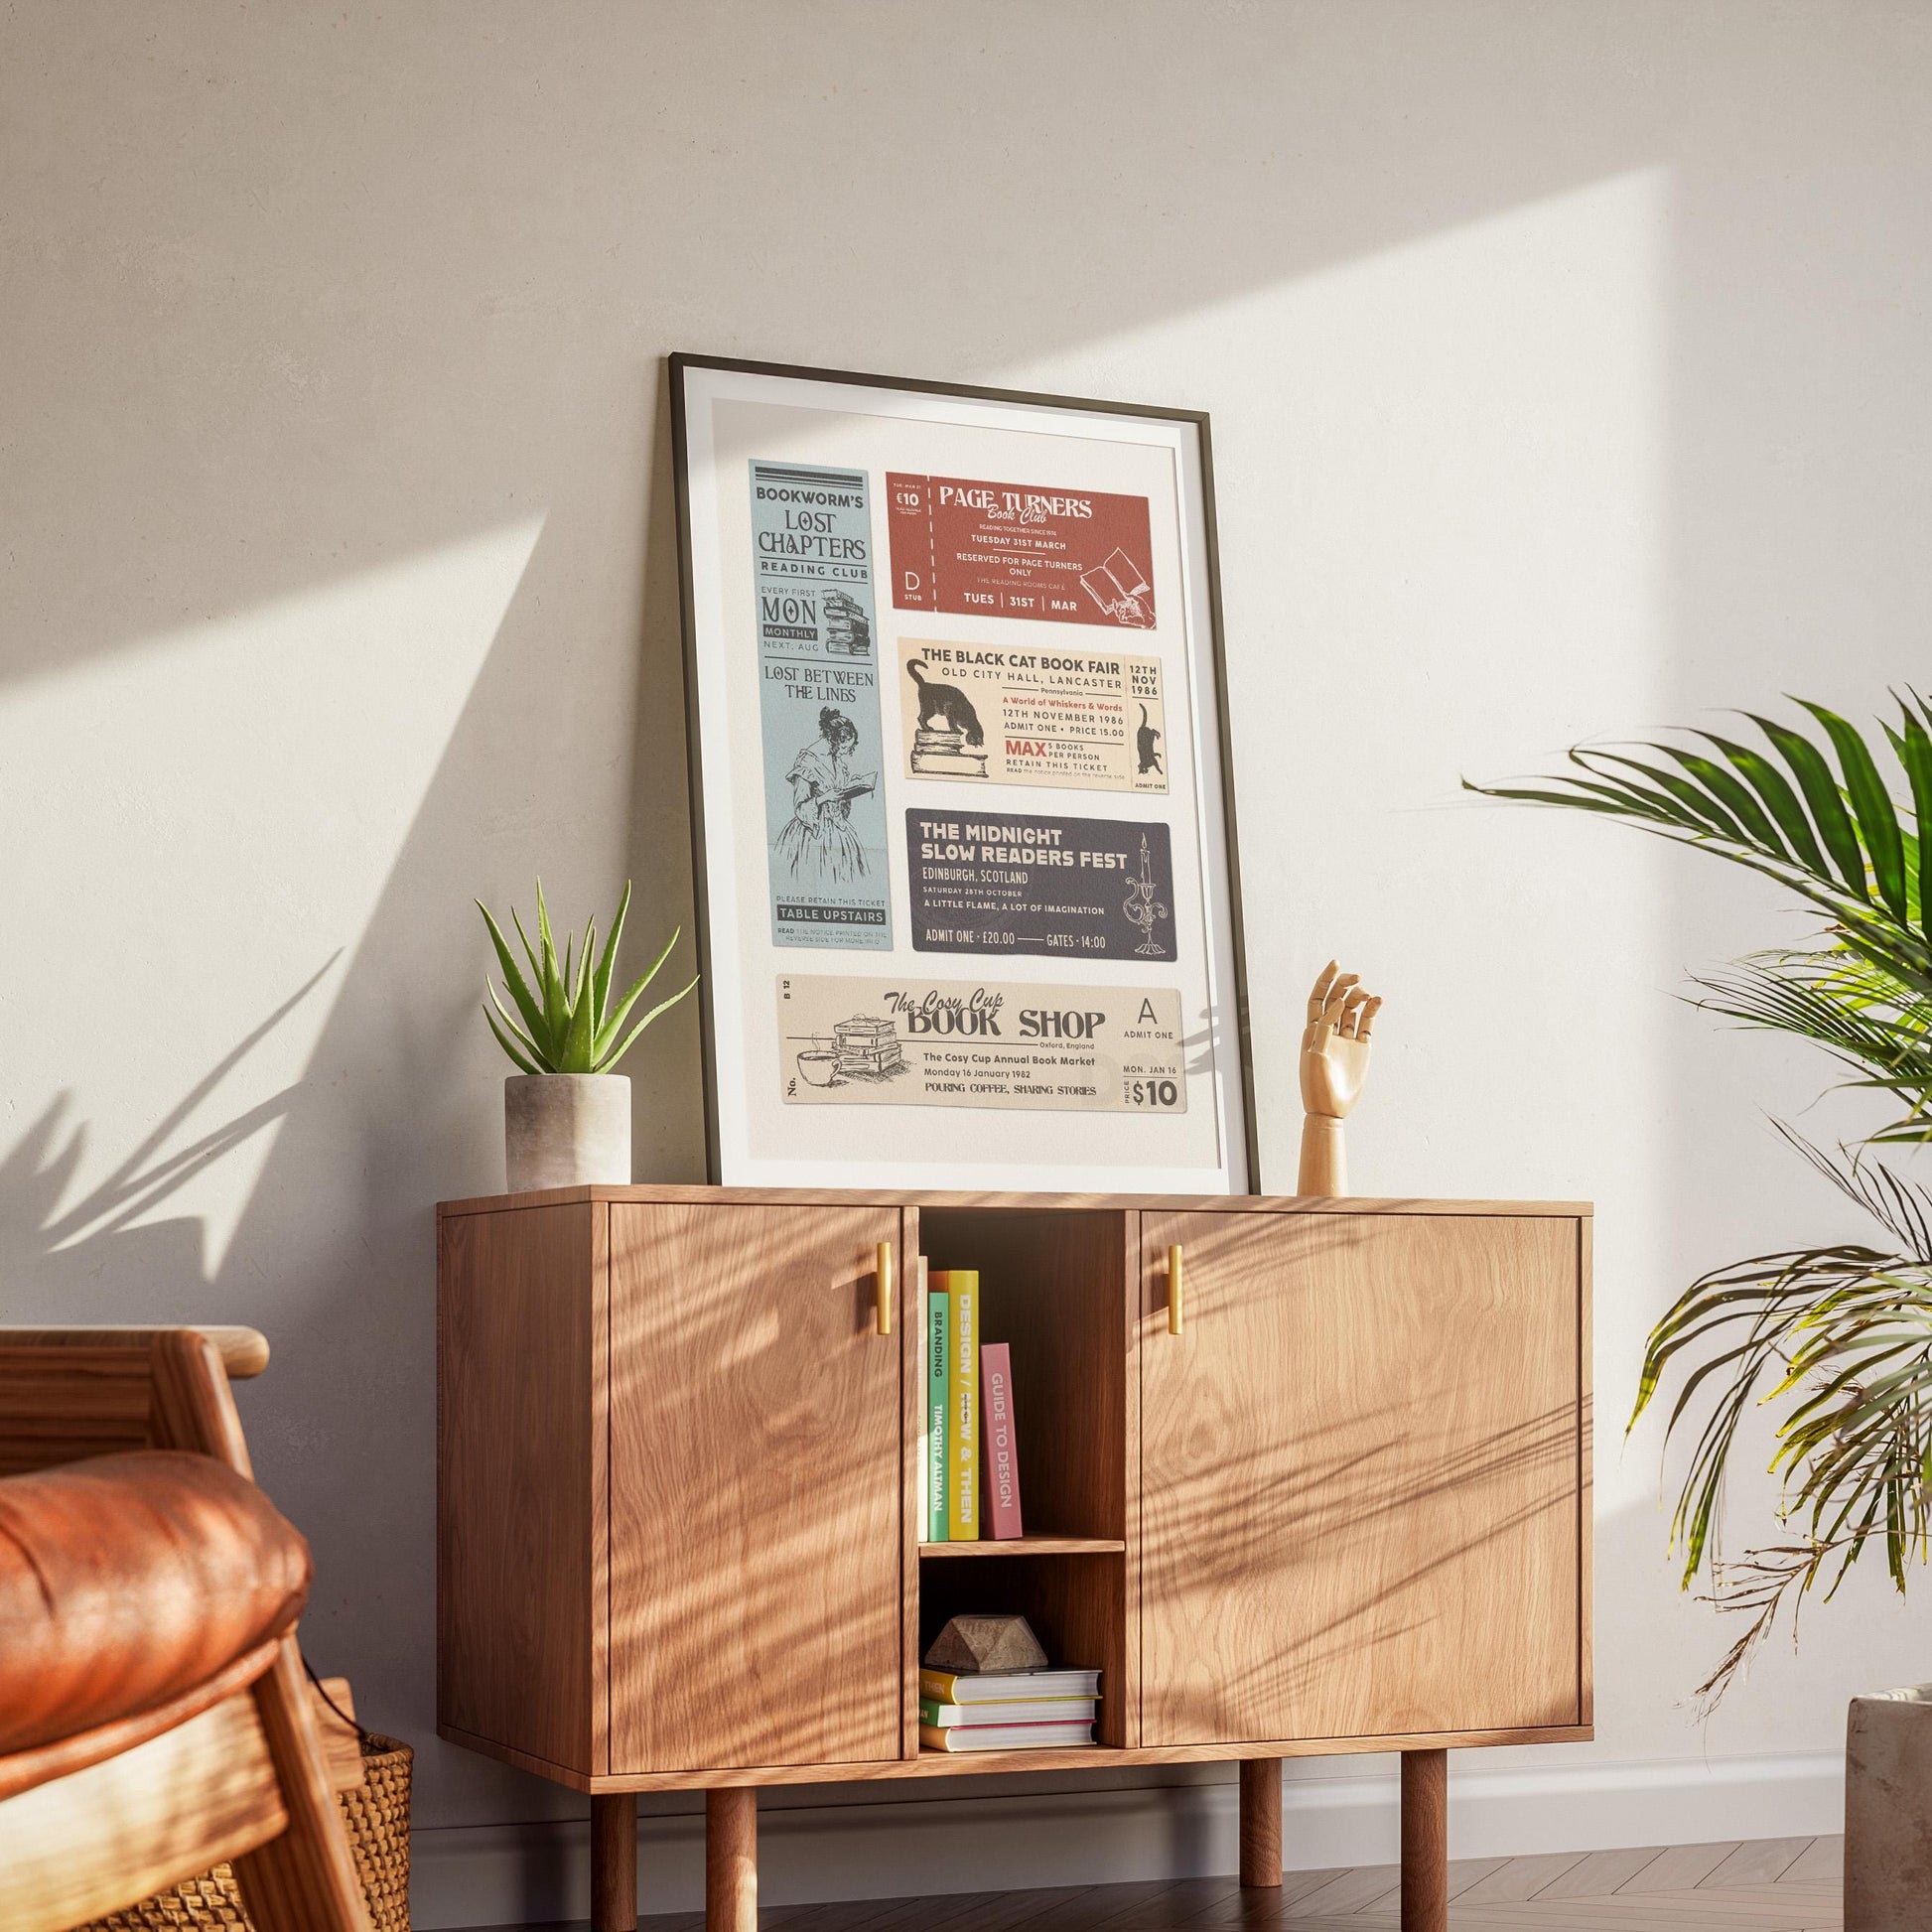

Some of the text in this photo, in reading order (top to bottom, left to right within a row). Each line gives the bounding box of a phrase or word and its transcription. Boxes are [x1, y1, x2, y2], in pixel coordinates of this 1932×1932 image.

[757, 486, 863, 508] BOOKWORM'S
[897, 492, 919, 506] €10
[939, 485, 1092, 518] PAGE TURNERS
[785, 509, 836, 533] LOST
[988, 504, 1046, 524] Book Club
[759, 531, 866, 559] CHAPTERS
[971, 535, 1066, 550] TUESDAY 31ST MARCH
[761, 562, 868, 579] READING CLUB
[957, 553, 1000, 563] RESERVED
[1044, 561, 1082, 571] TURNERS
[905, 572, 919, 590] D
[761, 596, 816, 624] MON
[964, 593, 1077, 611] TUES 31ST MAR
[765, 627, 815, 638] MONTHLY
[922, 648, 1120, 674] THE BLACK CAT BOOK FAIR
[1130, 665, 1156, 674] 12TH
[764, 666, 874, 686] LOST BETWEEN
[942, 668, 1122, 689] OLD CITY HALL, LANCASTER
[1132, 675, 1156, 684] NOV
[785, 685, 856, 702] THE LINES
[1132, 686, 1157, 695] 1986
[1012, 697, 1035, 706] World
[1048, 700, 1086, 709] Whiskers
[1004, 709, 1123, 725] 12TH NOVEMBER 1986
[1006, 740, 1046, 758] MAX
[920, 822, 1061, 845] THE MIDNIGHT
[921, 843, 1127, 869] SLOW READERS FEST
[981, 871, 1028, 884] SCOTLAND
[780, 908, 883, 921] TABLE UPSTAIRS
[966, 901, 999, 910] FLAME,
[1044, 905, 1104, 914] IMAGINATION
[926, 929, 1105, 948] ADMIT ONE £20.00 GATES 14:00
[884, 987, 1005, 1015] The Cosy Cup
[1137, 998, 1158, 1025] A
[907, 1006, 1106, 1038] BOOK SHOP
[945, 1053, 968, 1064] Cosy
[972, 1054, 991, 1064] Cup
[995, 1055, 1030, 1064] Annual
[1033, 1056, 1056, 1065] Book
[1060, 1056, 1095, 1065] Market
[924, 1068, 960, 1077] Monday
[974, 1070, 1010, 1079] January
[925, 1082, 1096, 1095] POURING COFFEE, SHARING STORIES
[1133, 1080, 1177, 1106] $10
[960, 1295, 971, 1372] DESIGN
[992, 1373, 1012, 1508] GUIDE TO DESIGN
[933, 1405, 942, 1511] TIMOTHY ALTMAN
[961, 1448, 971, 1461] &
[961, 1468, 971, 1523] THEN
